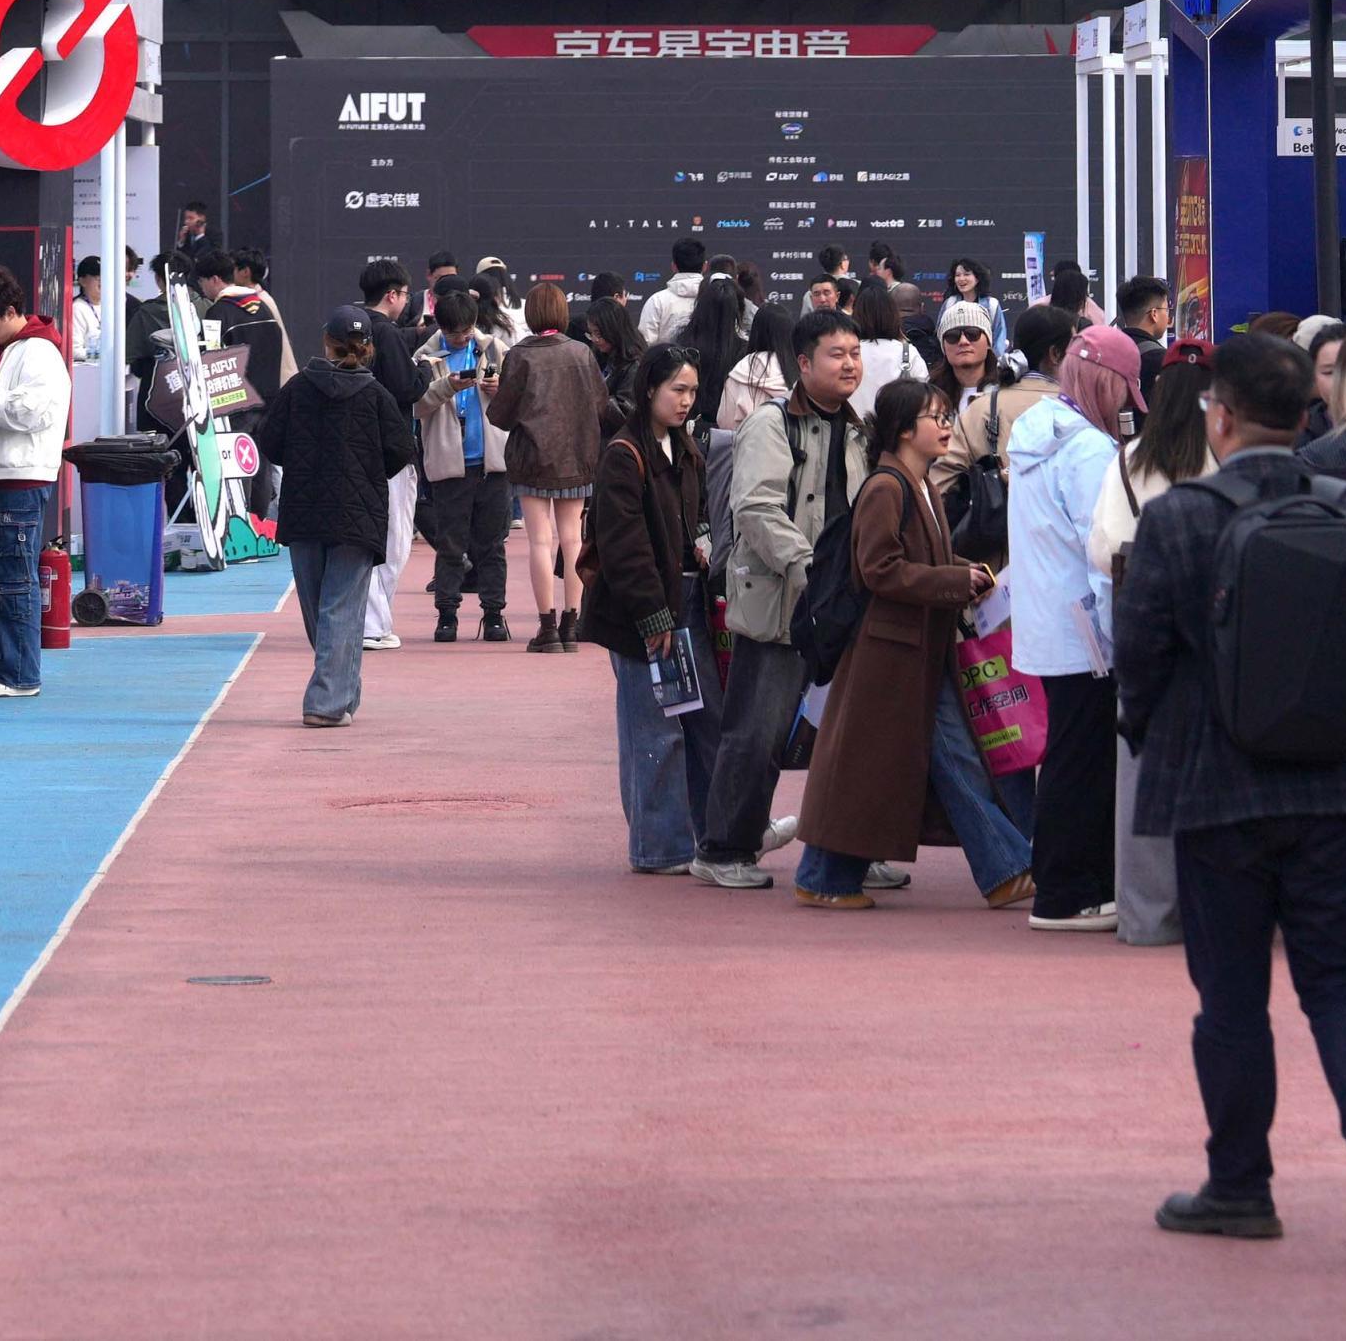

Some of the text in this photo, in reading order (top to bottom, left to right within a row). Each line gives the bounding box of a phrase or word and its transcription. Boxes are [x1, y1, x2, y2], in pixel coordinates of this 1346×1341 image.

[338, 93, 426, 121] AIFUT
[688, 173, 704, 181] 飞书
[365, 193, 420, 207] 虚实传媒
